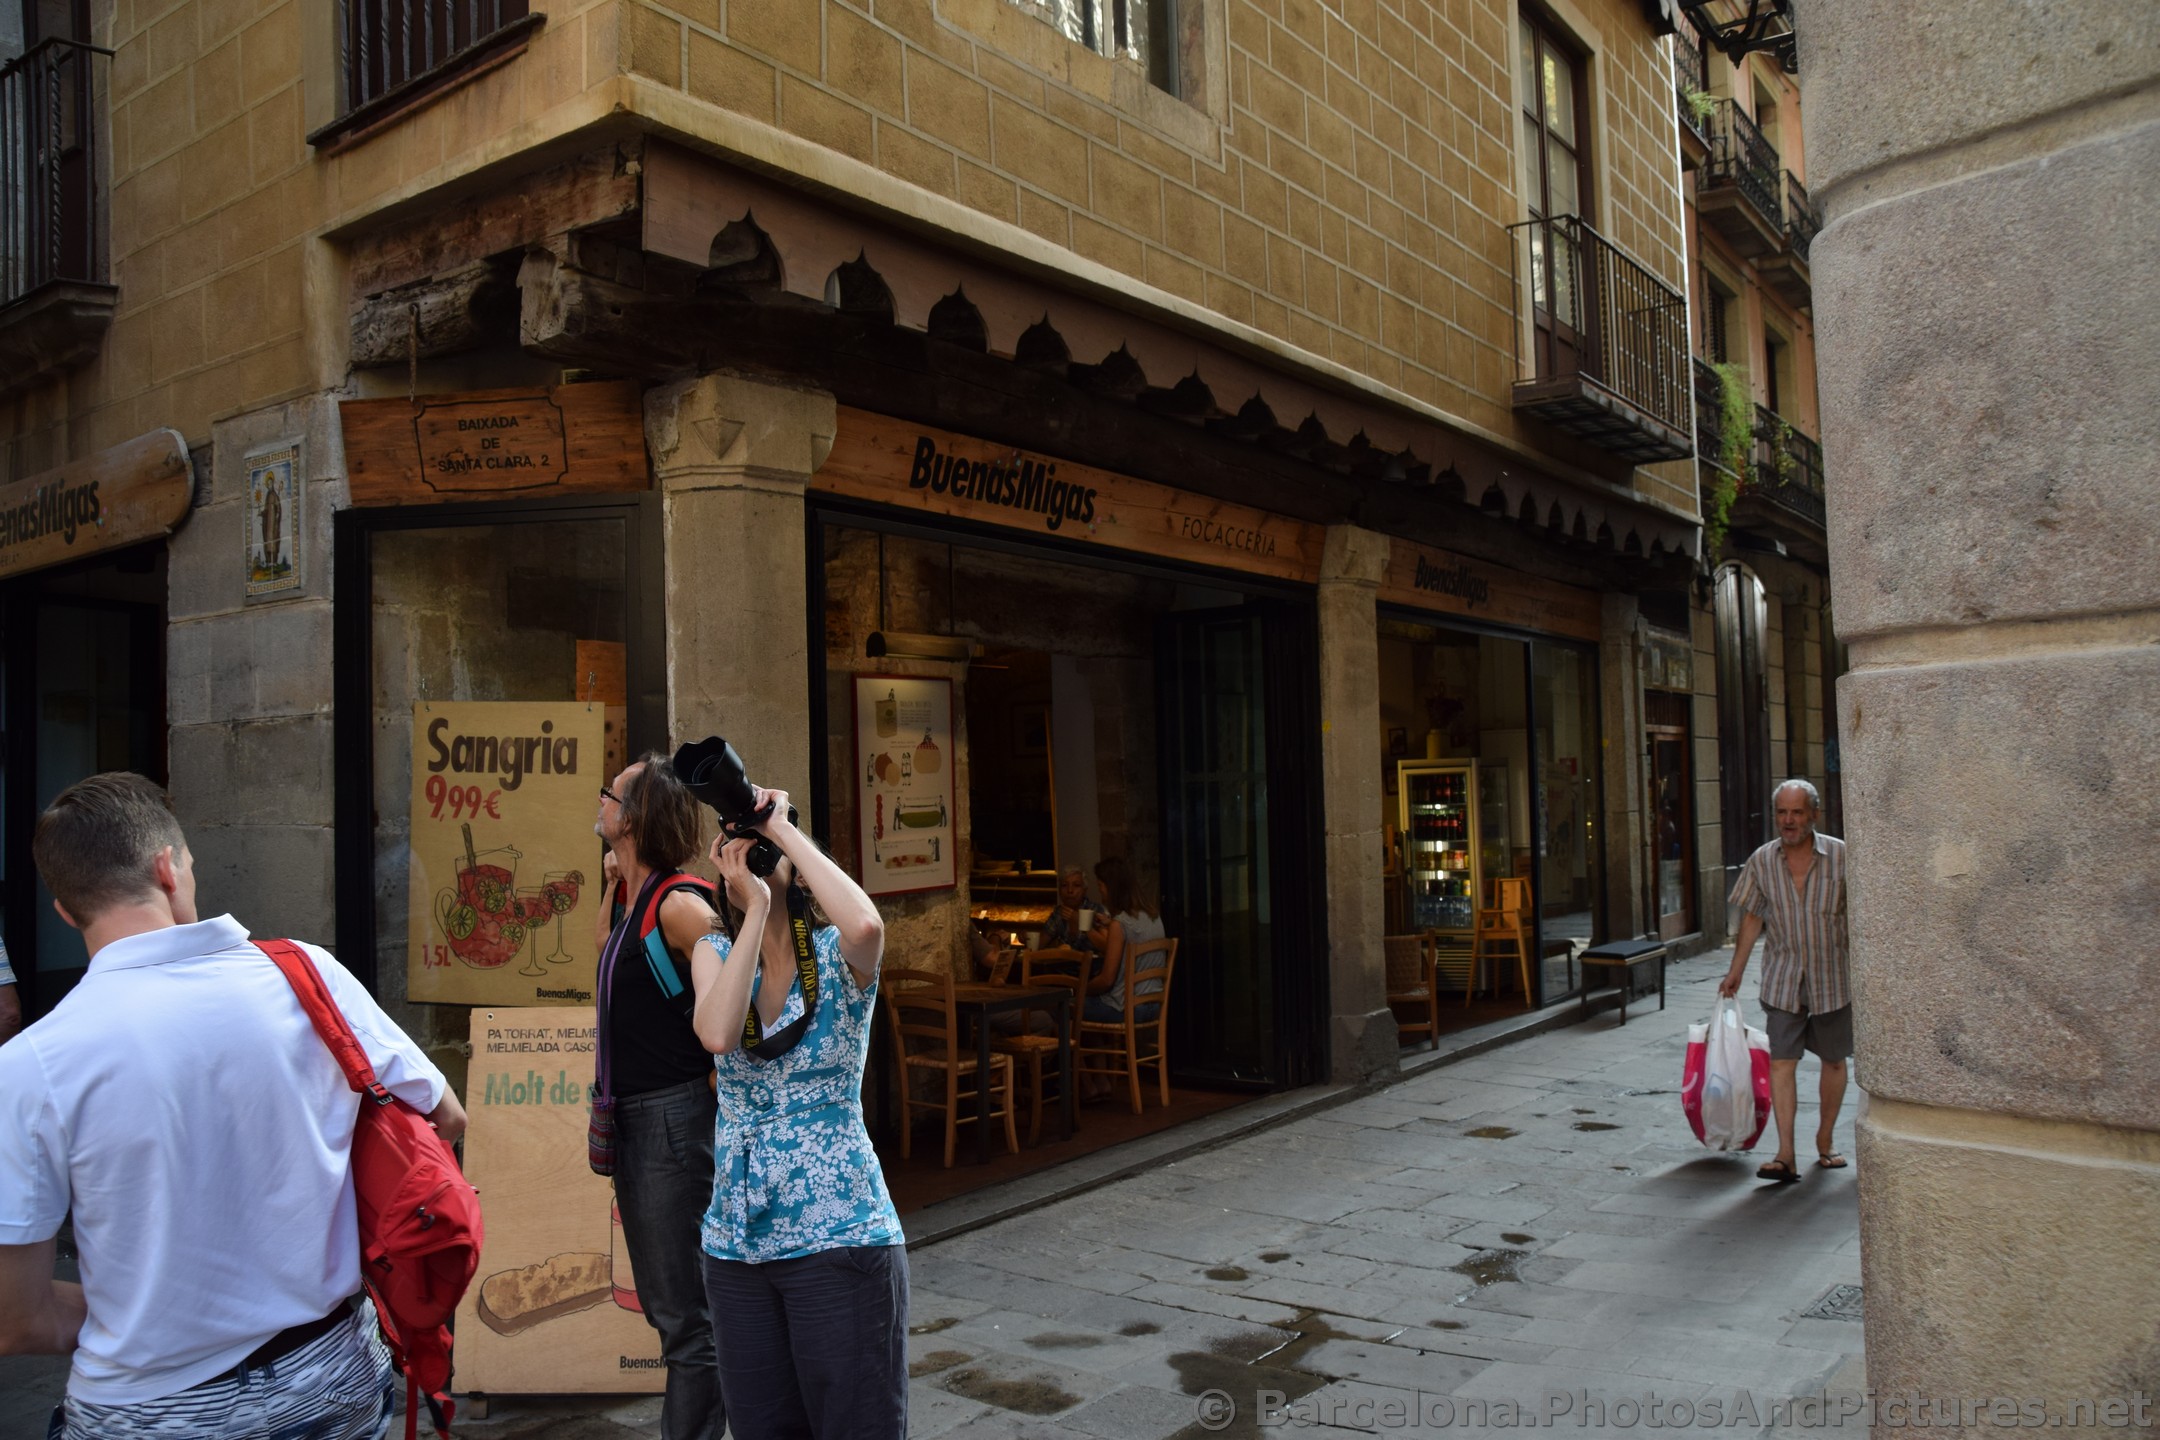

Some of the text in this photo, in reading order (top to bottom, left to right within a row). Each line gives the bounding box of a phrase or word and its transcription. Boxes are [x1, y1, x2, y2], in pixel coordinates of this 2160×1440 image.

[458, 416, 519, 431] BAIXADA
[481, 438, 500, 449] DE
[438, 455, 550, 472] SANTA CLARA, 2
[909, 436, 1097, 530] BuenasMigas
[1182, 516, 1275, 557] FOCACCERIA
[1414, 555, 1489, 608] BuenasMigas
[427, 717, 578, 791] Sangria
[425, 774, 501, 822] 9,99€
[793, 918, 809, 957] Nikon
[422, 944, 452, 970] 1,5L
[536, 987, 592, 1002] BuenasMigas
[487, 1042, 560, 1053] MELMELADA
[488, 1029, 502, 1040] PA
[504, 1028, 553, 1041] TORRAT,
[484, 1069, 545, 1105] Molt
[549, 1069, 580, 1105] de
